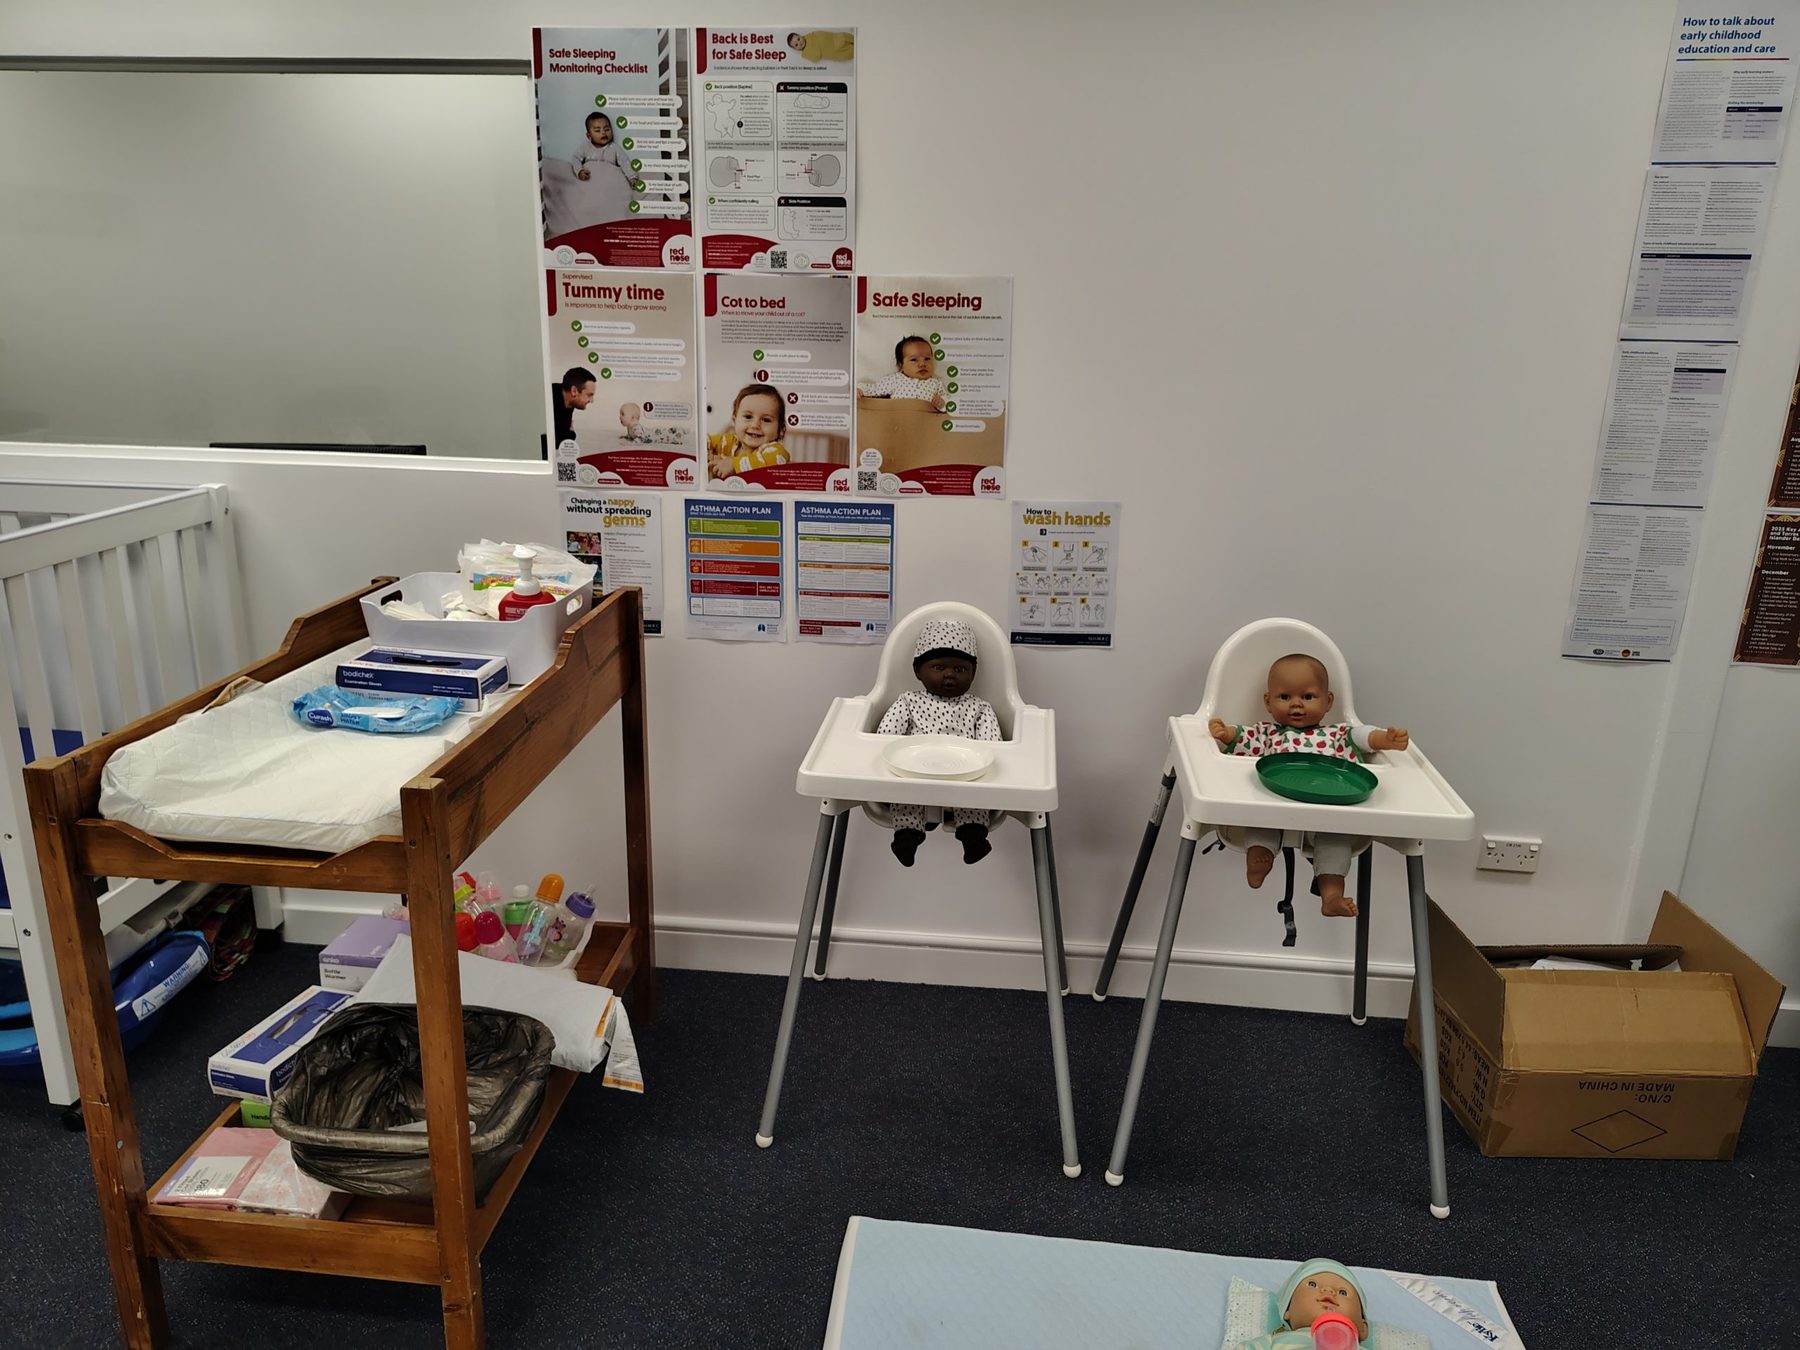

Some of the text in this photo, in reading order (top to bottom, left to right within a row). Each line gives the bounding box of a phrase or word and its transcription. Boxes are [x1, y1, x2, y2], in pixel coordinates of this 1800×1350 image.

[1682, 16, 1776, 27] How to talk about
[712, 33, 737, 45] Back
[750, 33, 774, 45] Best
[1680, 30, 1762, 42] early childhood
[549, 48, 616, 61] Safe Sleeping
[1678, 44, 1776, 54] education and care
[711, 49, 787, 62] for Safe Sleep
[549, 63, 649, 75] Monitoring Checklist
[669, 247, 685, 255] red
[669, 254, 690, 262] nose
[562, 282, 665, 302] Tummy time
[569, 302, 597, 310] important
[604, 303, 617, 311] help
[617, 304, 632, 312] baby
[721, 296, 786, 309] Cot to bed
[872, 292, 982, 311] Safe Sleeping
[674, 468, 689, 476] red
[833, 479, 848, 487] red
[981, 477, 996, 485] red
[570, 497, 602, 505] Changing
[607, 498, 635, 508] nappy
[566, 504, 652, 518] without spreading
[690, 505, 772, 515] ASTHMA ACTION PLAN
[800, 507, 832, 515] ASTHMA
[832, 508, 861, 516] ACTION
[602, 515, 646, 528] germs
[1023, 511, 1112, 527] wash hands
[308, 712, 333, 722] Curash
[1578, 1080, 1676, 1092] MADE IN CHINA
[1633, 1093, 1672, 1104] C/NO:
